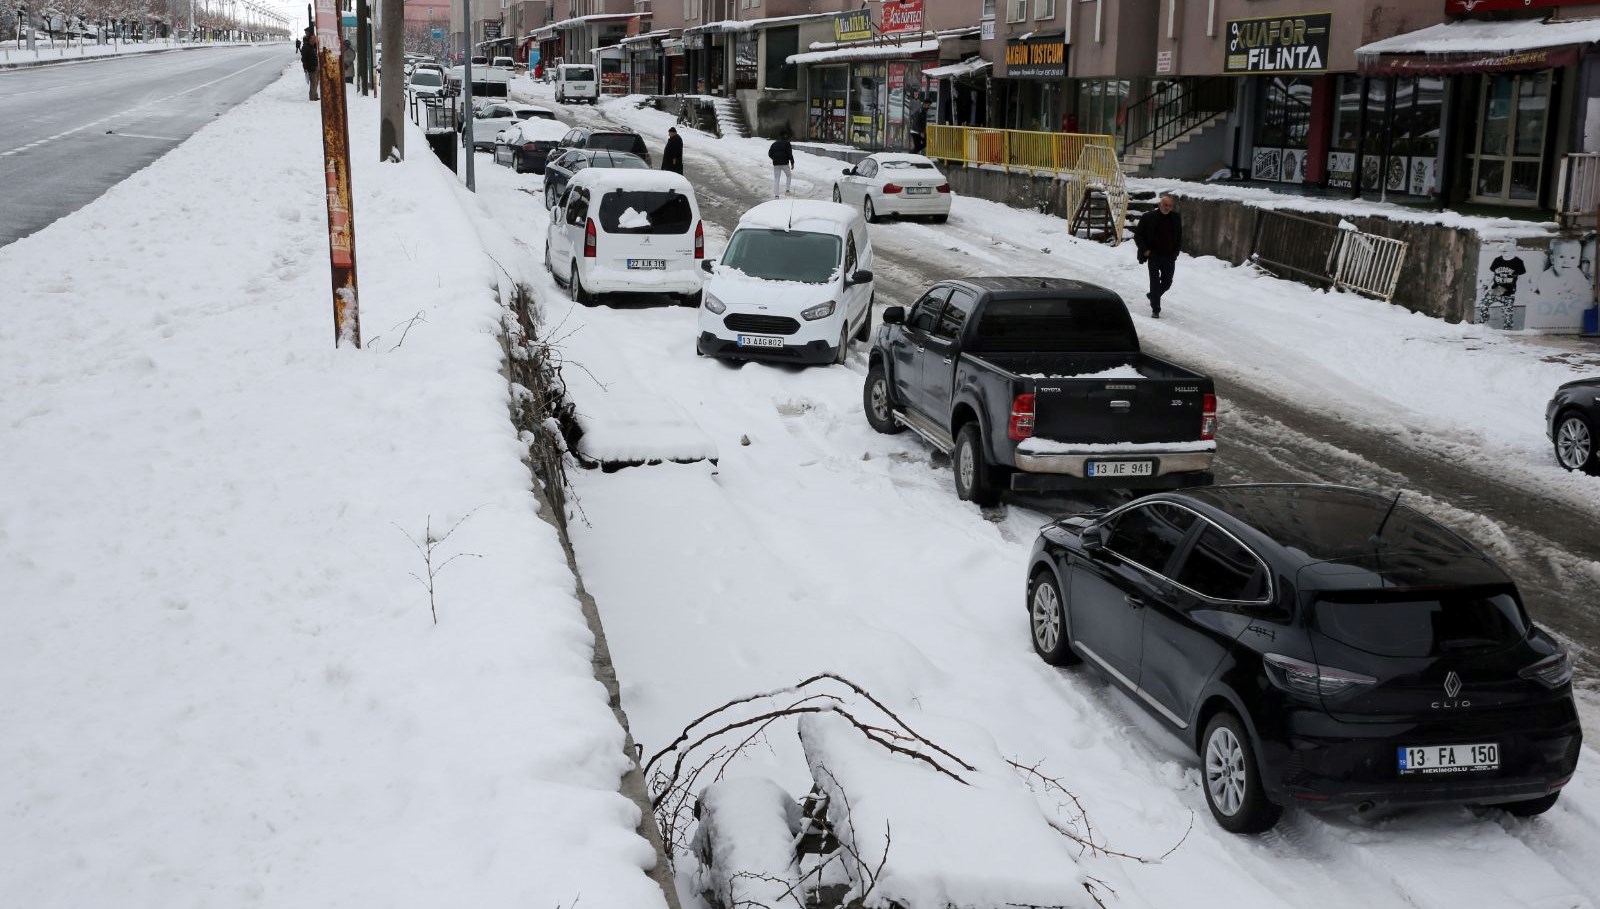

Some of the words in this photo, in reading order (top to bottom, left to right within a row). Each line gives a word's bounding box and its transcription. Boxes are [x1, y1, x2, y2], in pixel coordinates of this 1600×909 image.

[1005, 42, 1029, 65] AKGÜN
[1030, 43, 1064, 64] TOSTCUM
[1096, 464, 1107, 473] 13
[1114, 464, 1125, 473] AE
[1132, 463, 1149, 473] 941
[1409, 749, 1425, 766] 13
[1439, 747, 1456, 765] FA
[1471, 745, 1496, 764] 150
